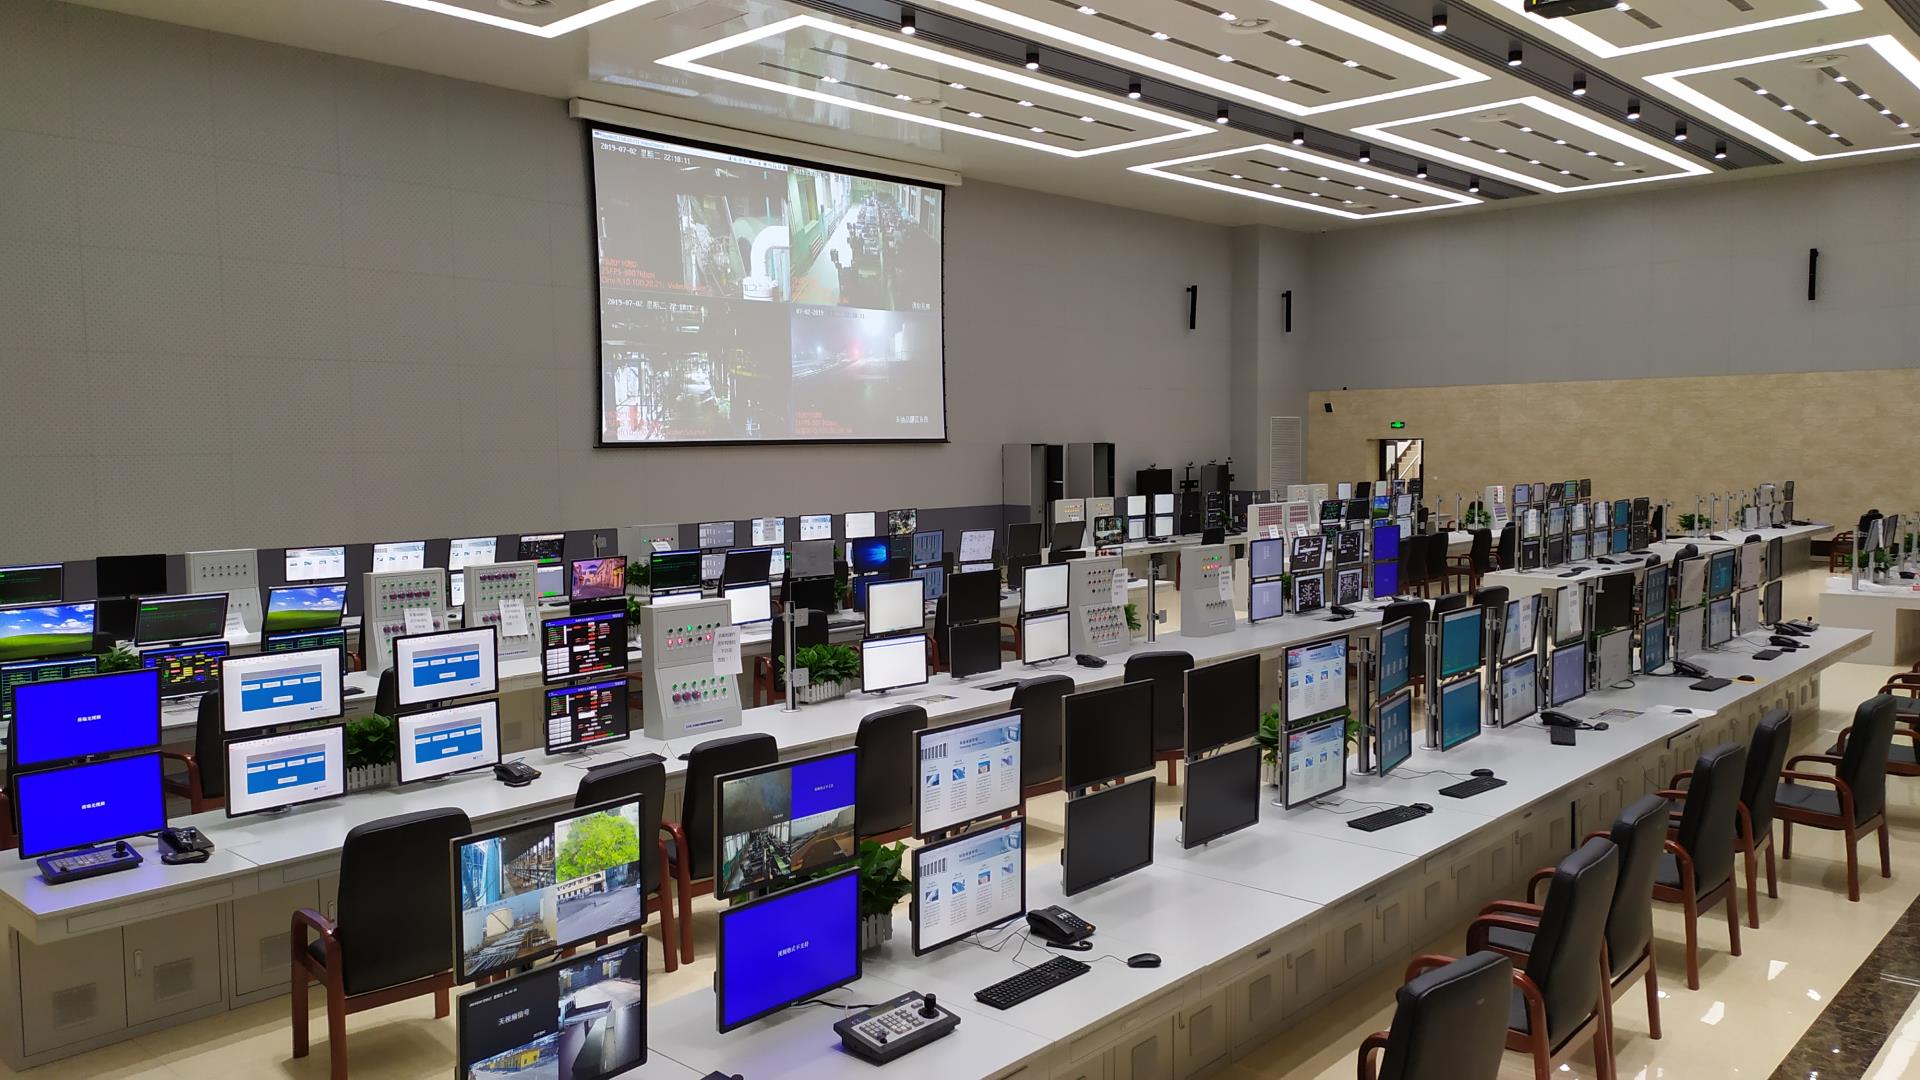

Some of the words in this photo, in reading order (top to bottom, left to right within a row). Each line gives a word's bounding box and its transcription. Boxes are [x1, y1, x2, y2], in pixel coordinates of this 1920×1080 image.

[600, 142, 637, 155] 2019-07-02
[499, 1008, 530, 1025] 无视频信号
